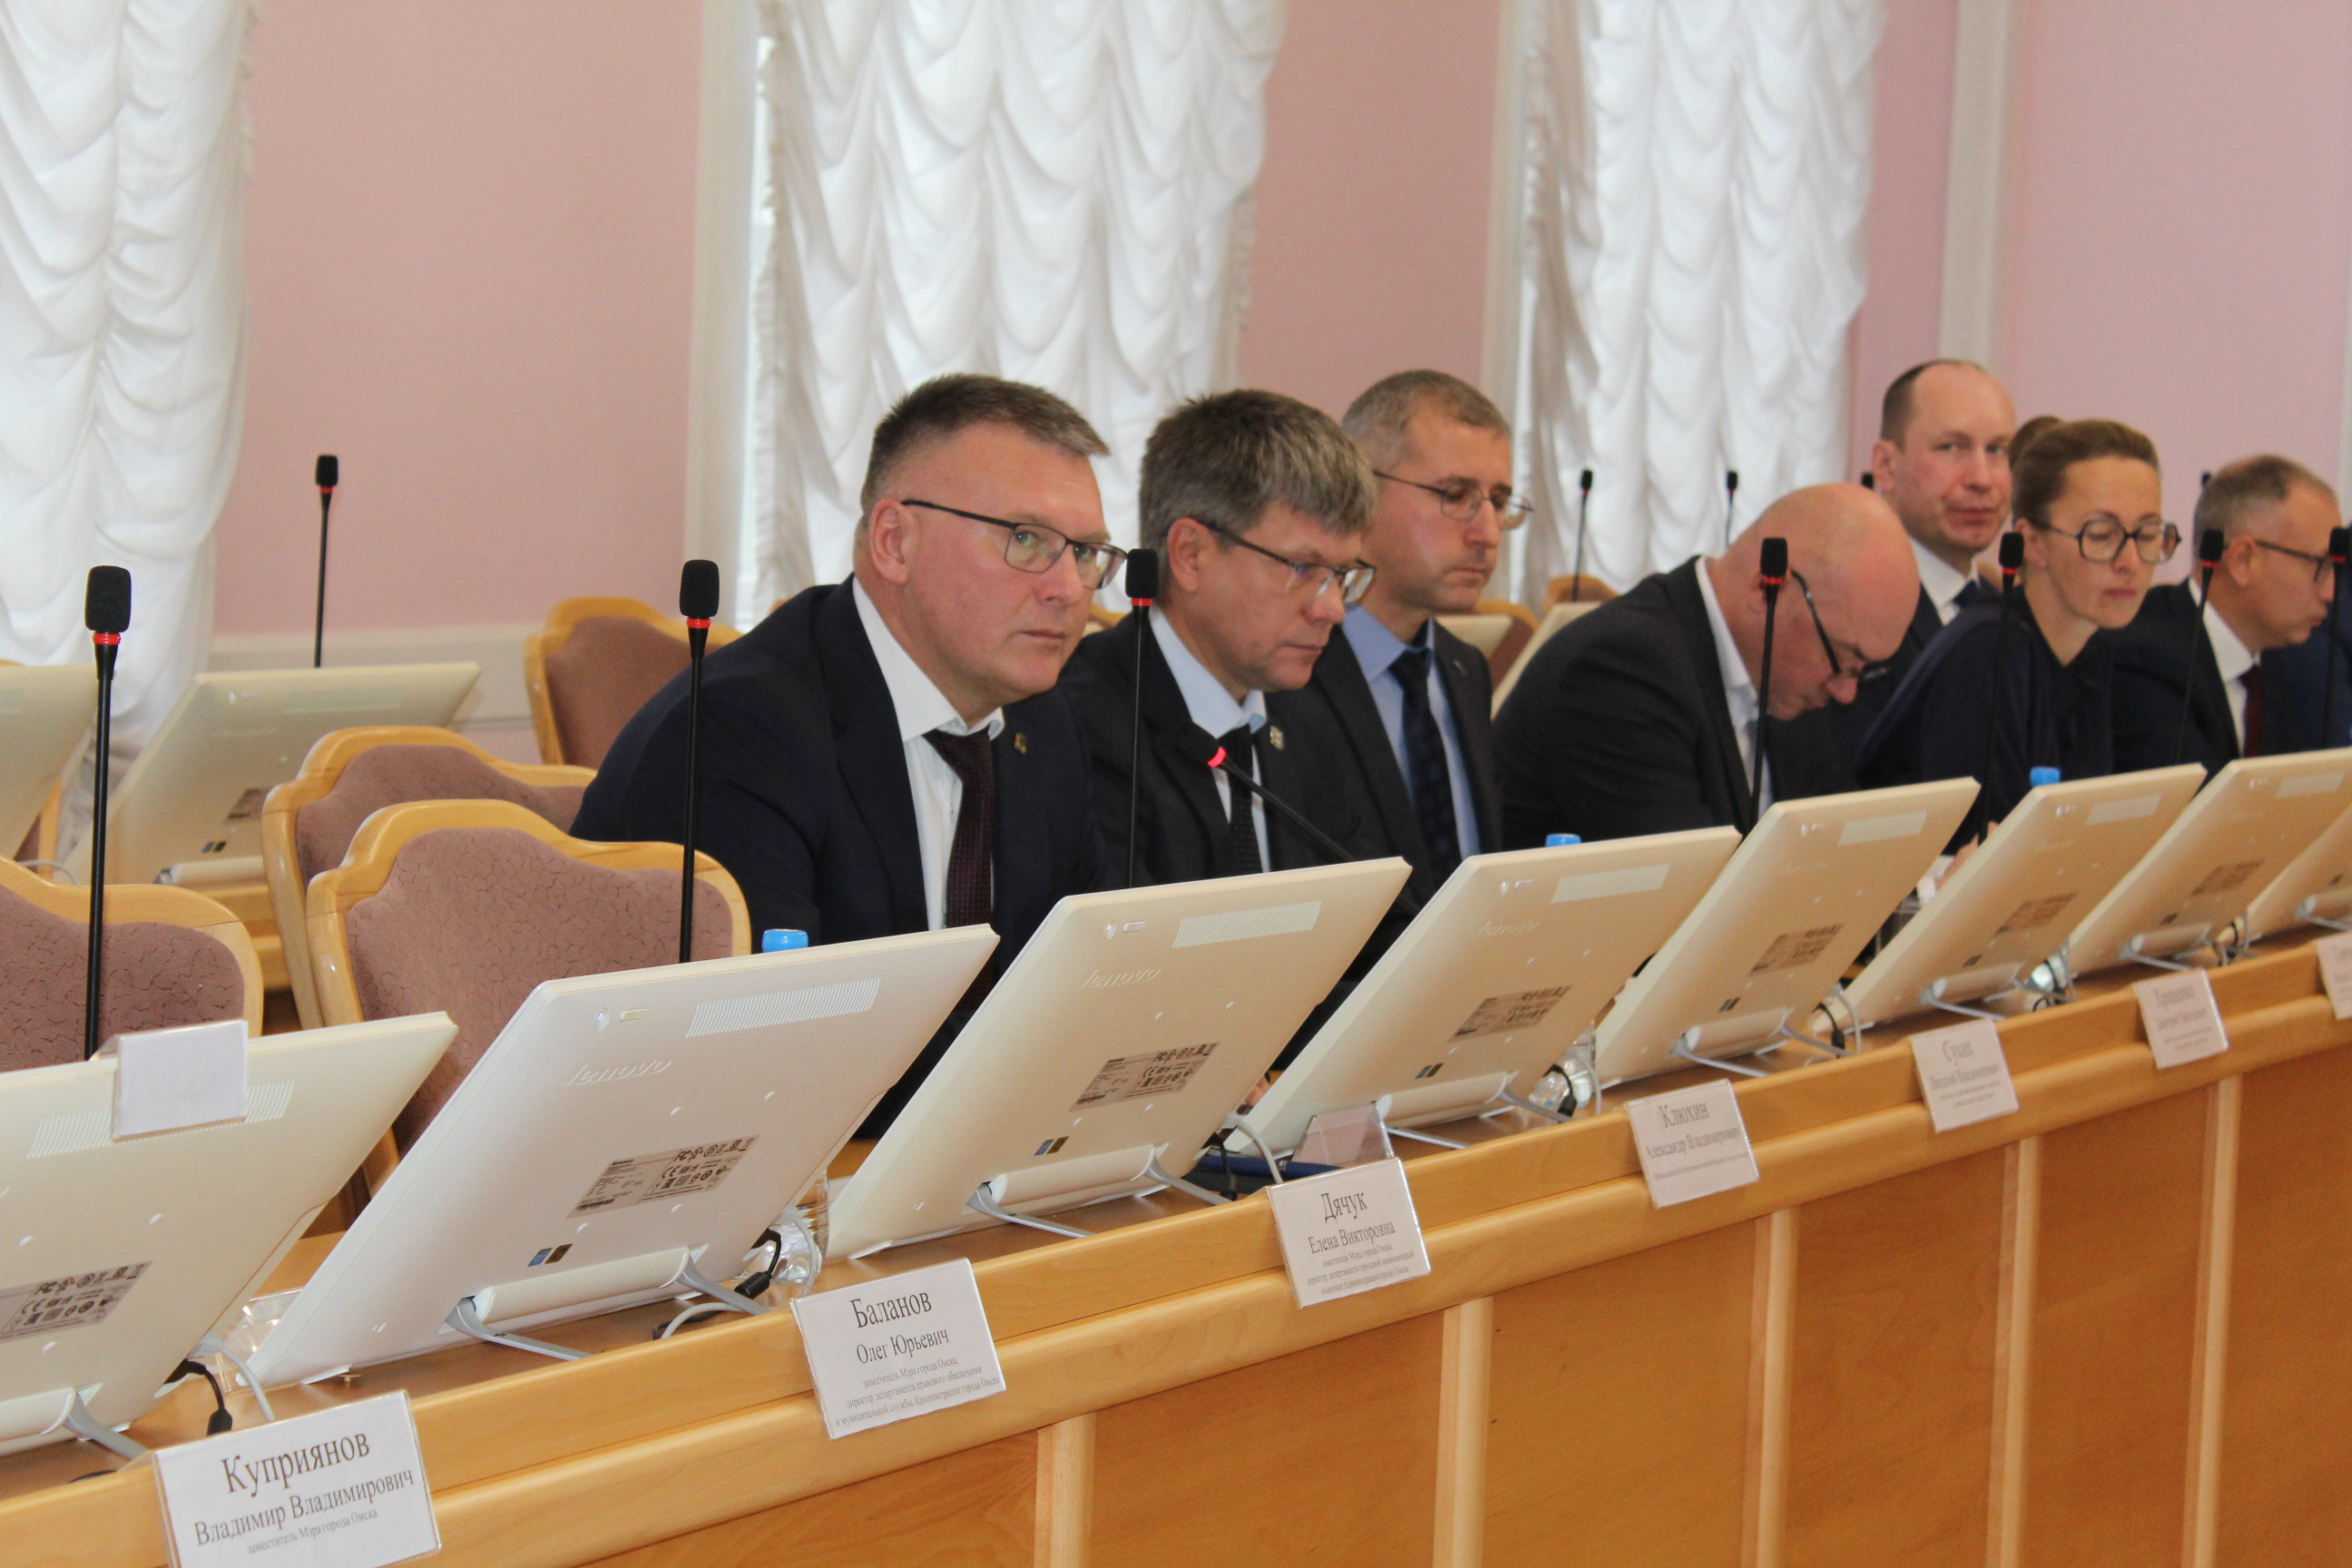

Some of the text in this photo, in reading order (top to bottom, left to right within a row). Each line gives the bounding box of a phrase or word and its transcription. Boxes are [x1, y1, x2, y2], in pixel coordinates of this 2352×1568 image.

[1077, 967, 1161, 989] lenovo
[564, 1059, 672, 1085] lenovo
[1658, 1102, 1709, 1128] Клюхин
[1319, 1192, 1367, 1225] Дячук
[1308, 1221, 1395, 1253] Елена Викторовна
[849, 1292, 931, 1328] Баланов
[856, 1329, 948, 1364] Олег Юрьевич
[864, 1372, 899, 1387] заместитель
[899, 1367, 916, 1377] Мэра
[916, 1362, 937, 1375] города
[220, 1433, 369, 1497] Куприянов
[194, 1469, 413, 1545] Владимир Владимирович
[248, 1509, 377, 1553] заместитель Мэра города Омска
